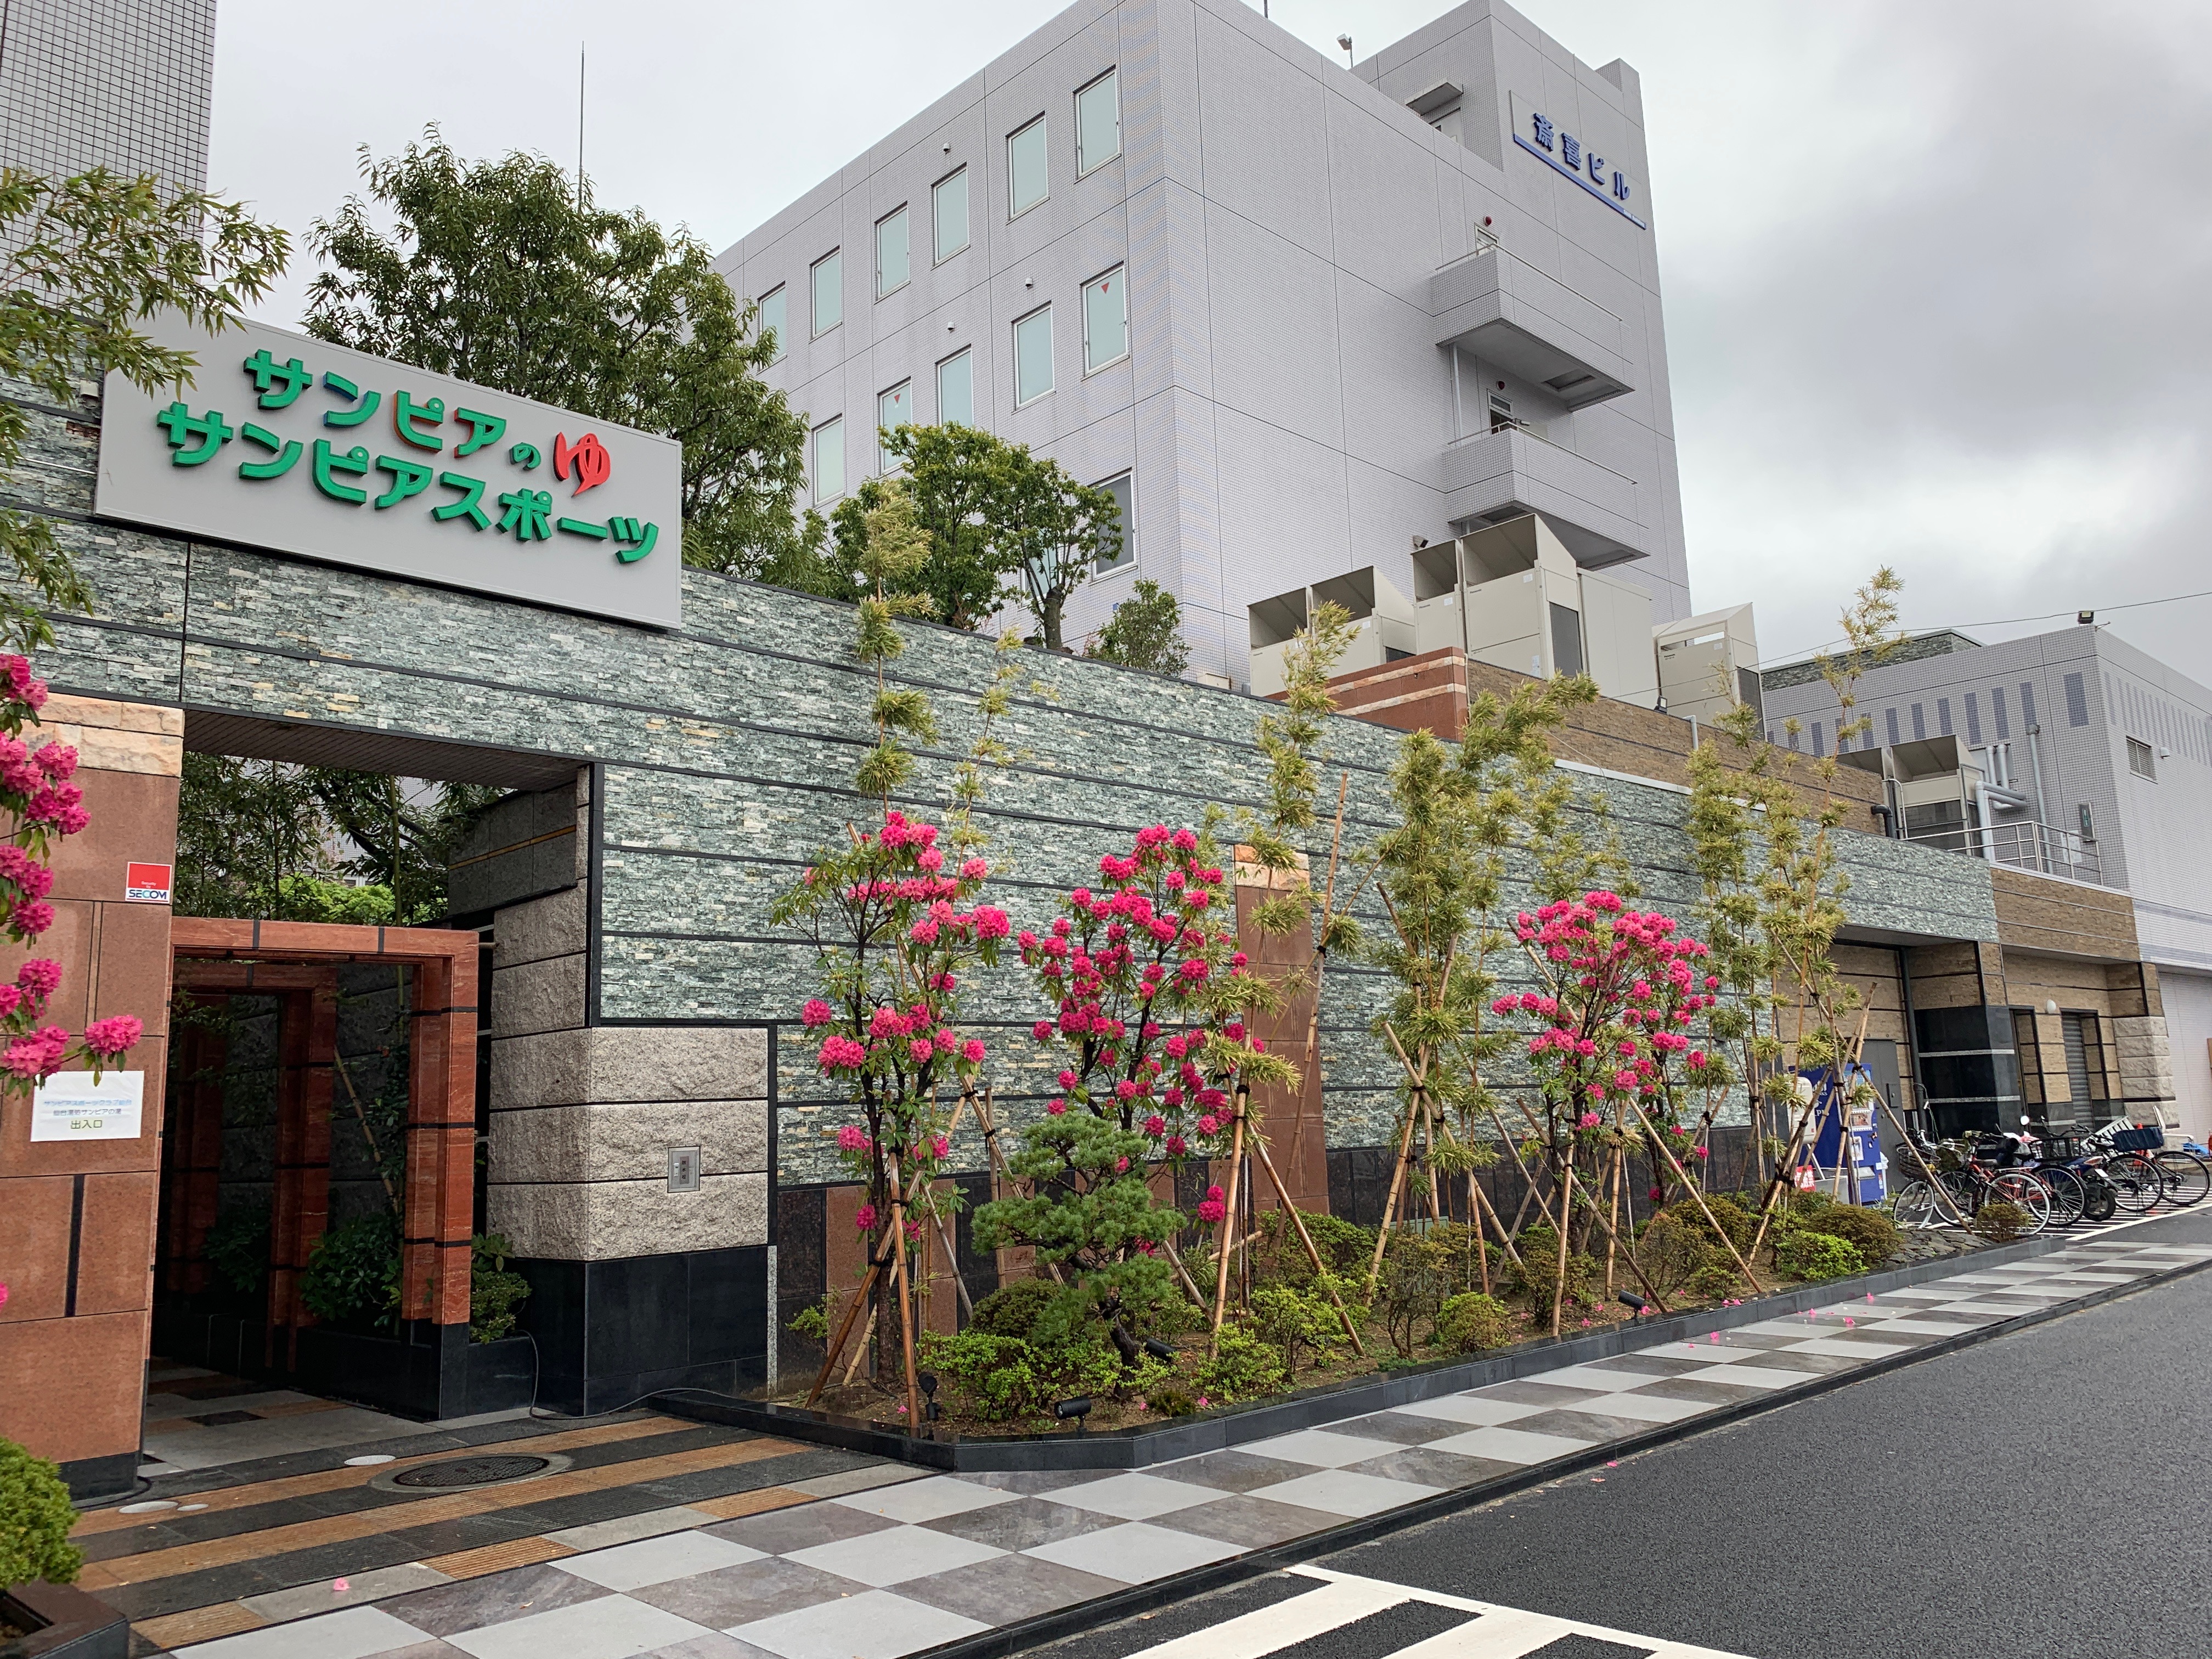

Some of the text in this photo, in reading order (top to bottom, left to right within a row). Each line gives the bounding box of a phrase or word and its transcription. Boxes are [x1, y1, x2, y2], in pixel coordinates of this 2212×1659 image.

[244, 348, 611, 497] サンピアのゆ
[156, 401, 659, 565] サンピアスポーツ
[129, 889, 166, 899] SECOM
[70, 1120, 103, 1129] 出入口
